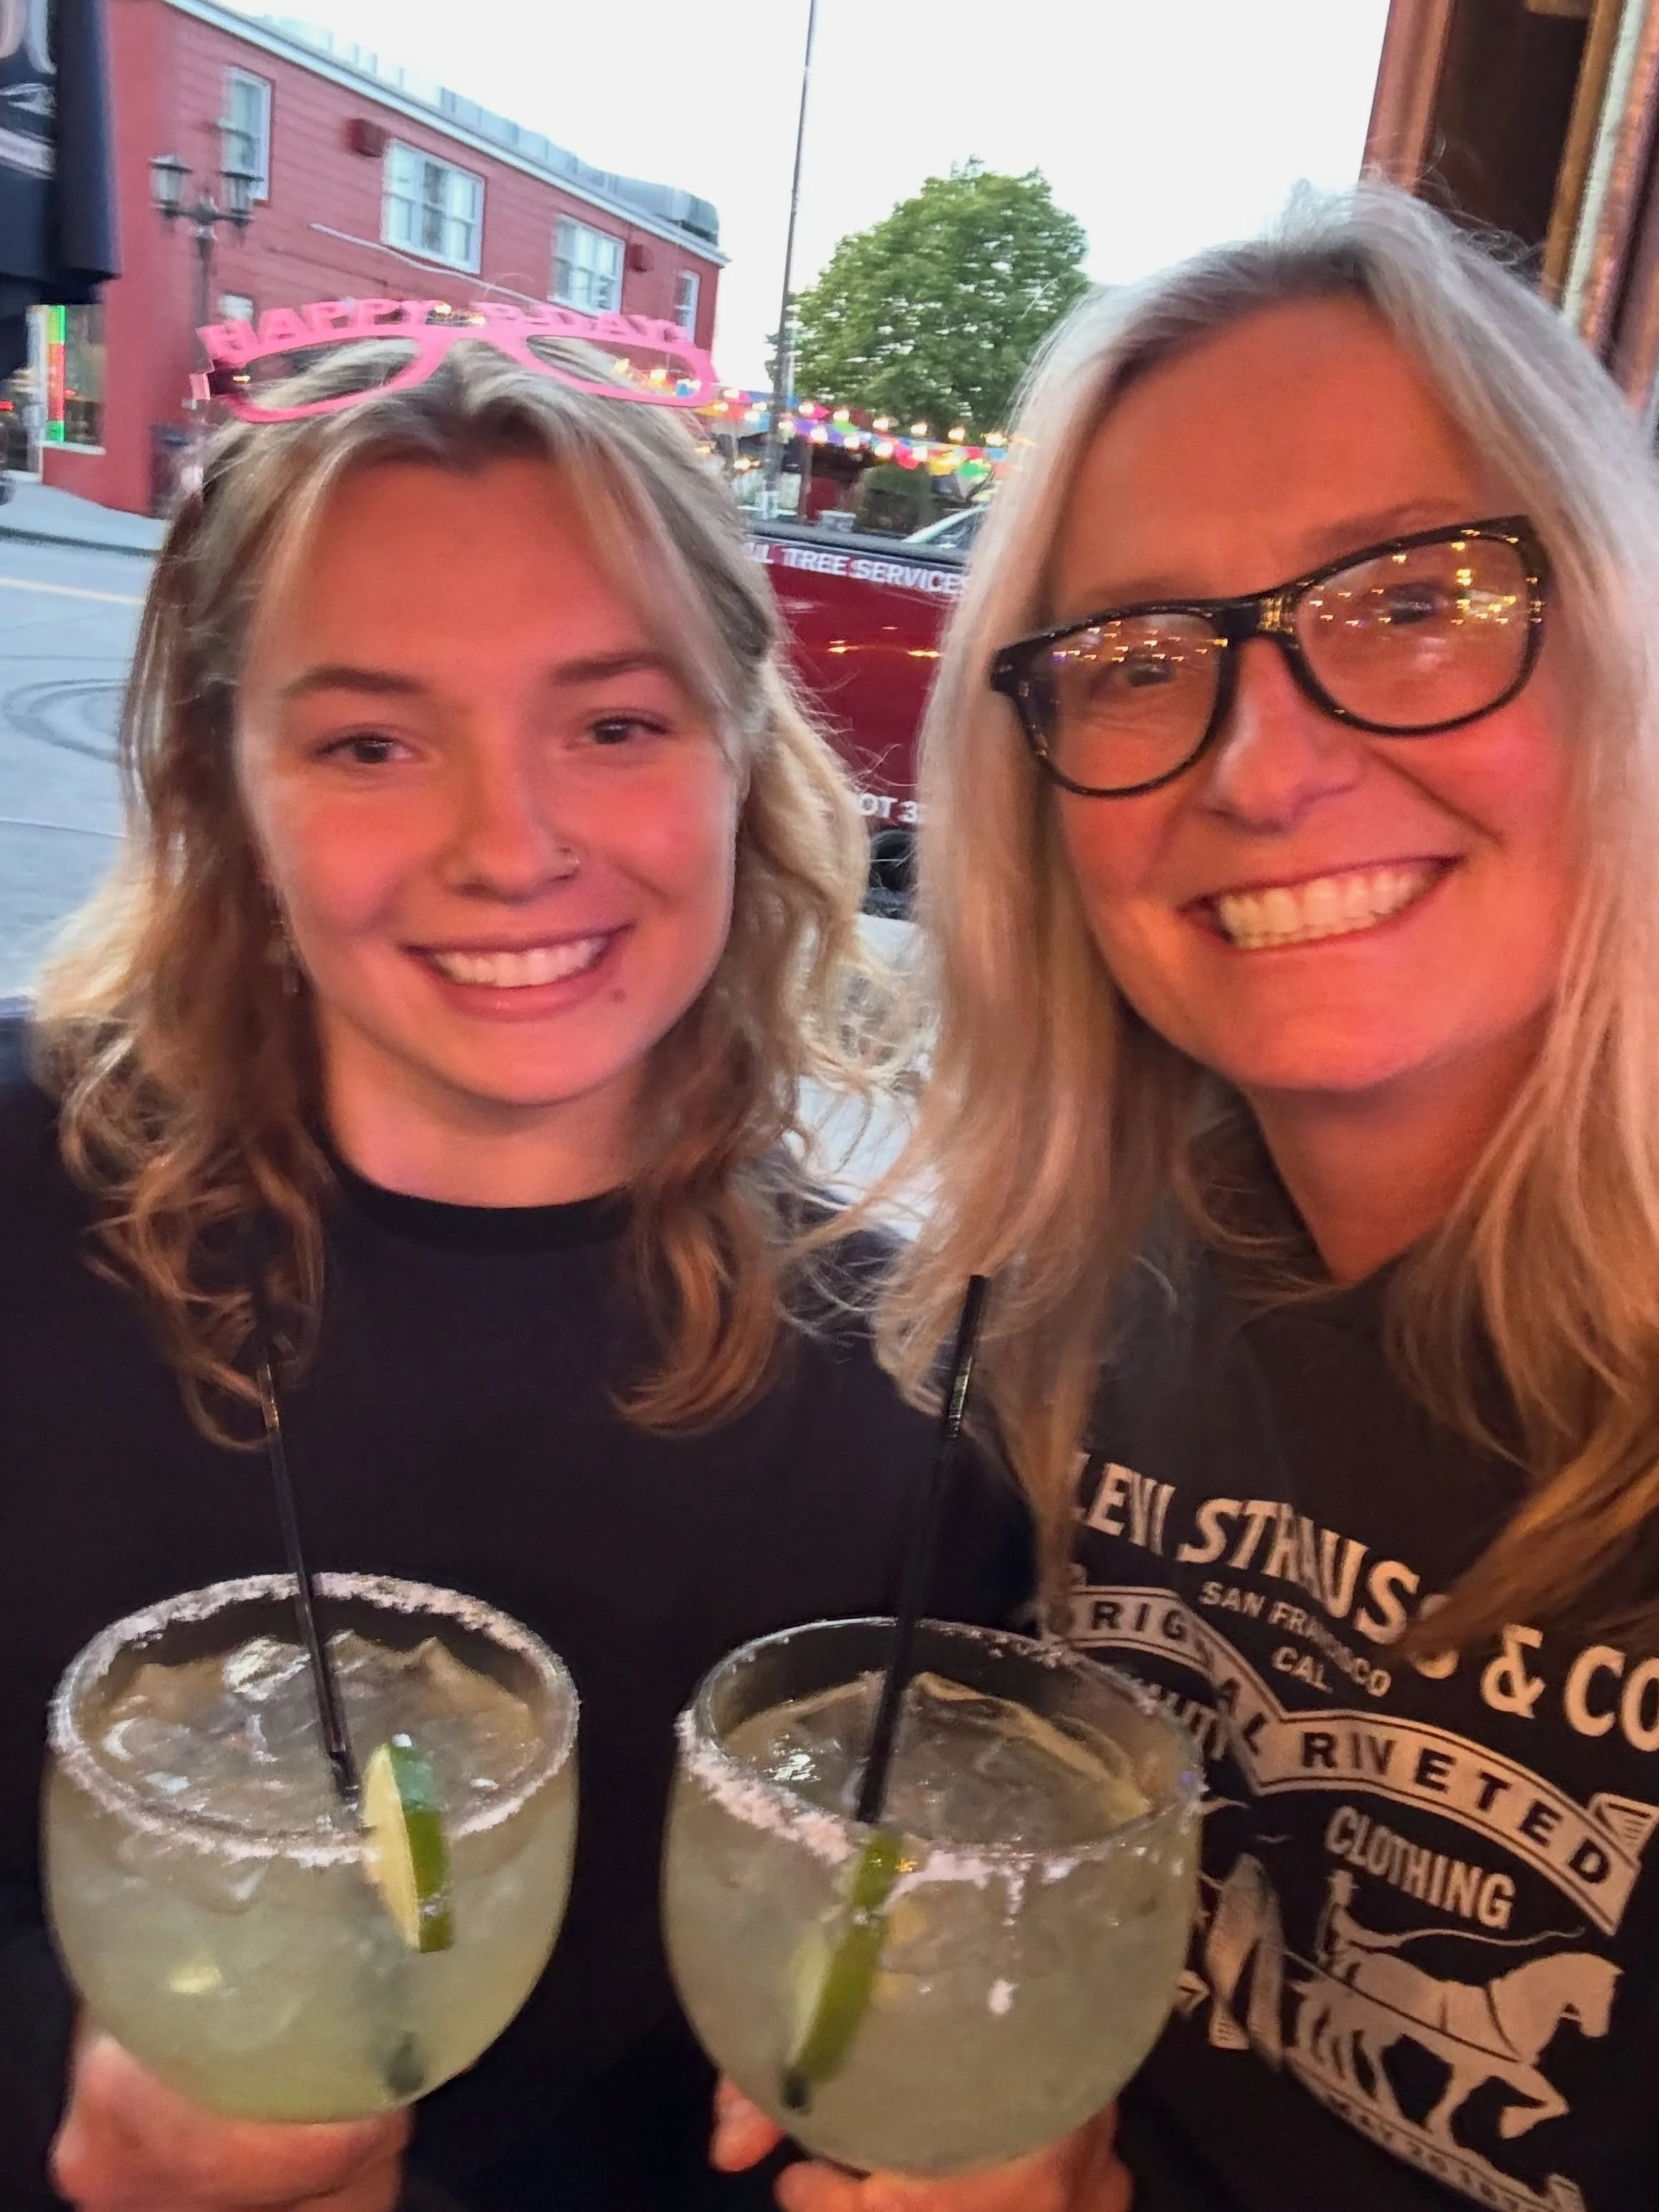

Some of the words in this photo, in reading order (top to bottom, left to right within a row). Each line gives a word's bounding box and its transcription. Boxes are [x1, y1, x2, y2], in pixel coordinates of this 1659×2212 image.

[195, 298, 443, 362] HAPPY
[780, 547, 850, 575] TREE
[1199, 1581, 1266, 1618] SAN
[1268, 1600, 1393, 1698] FRACO
[1480, 1623, 1546, 1719] &
[1301, 1730, 1612, 1884] RIVETED
[1324, 1805, 1516, 1930] CLOTHING
